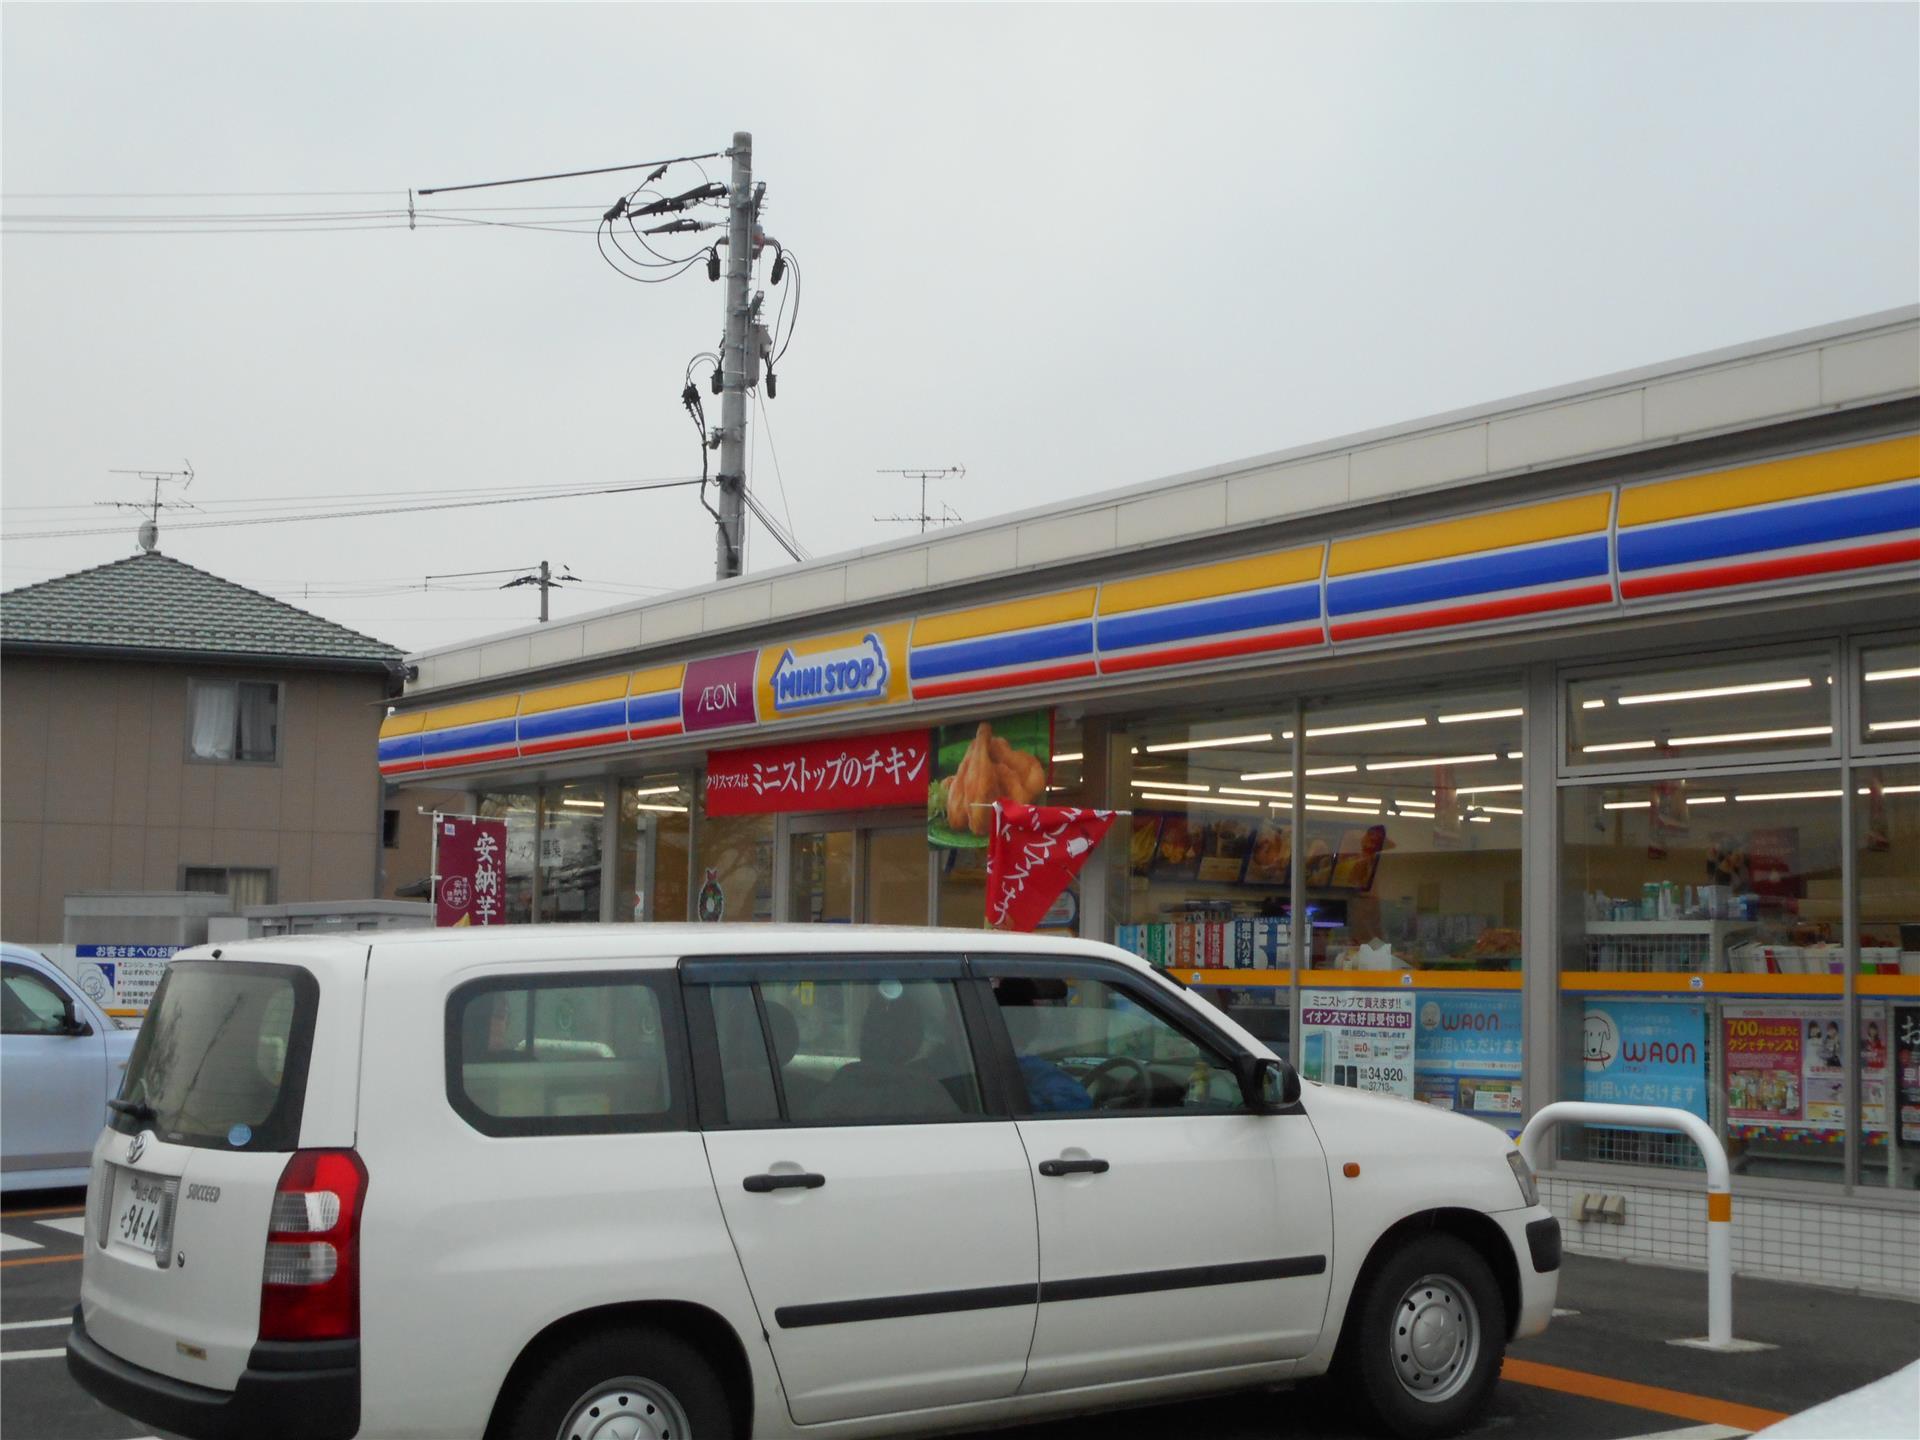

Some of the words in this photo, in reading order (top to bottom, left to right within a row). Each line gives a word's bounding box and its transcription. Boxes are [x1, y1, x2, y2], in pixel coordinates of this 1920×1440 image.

[780, 666, 823, 700] MINI
[825, 657, 875, 693] STOP
[473, 831, 498, 927] 安納芋
[96, 946, 183, 958] お客さまへのお願
[1441, 1012, 1500, 1032] WAON
[1622, 1041, 1697, 1065] WAON
[186, 1183, 221, 1203] SUCCEED
